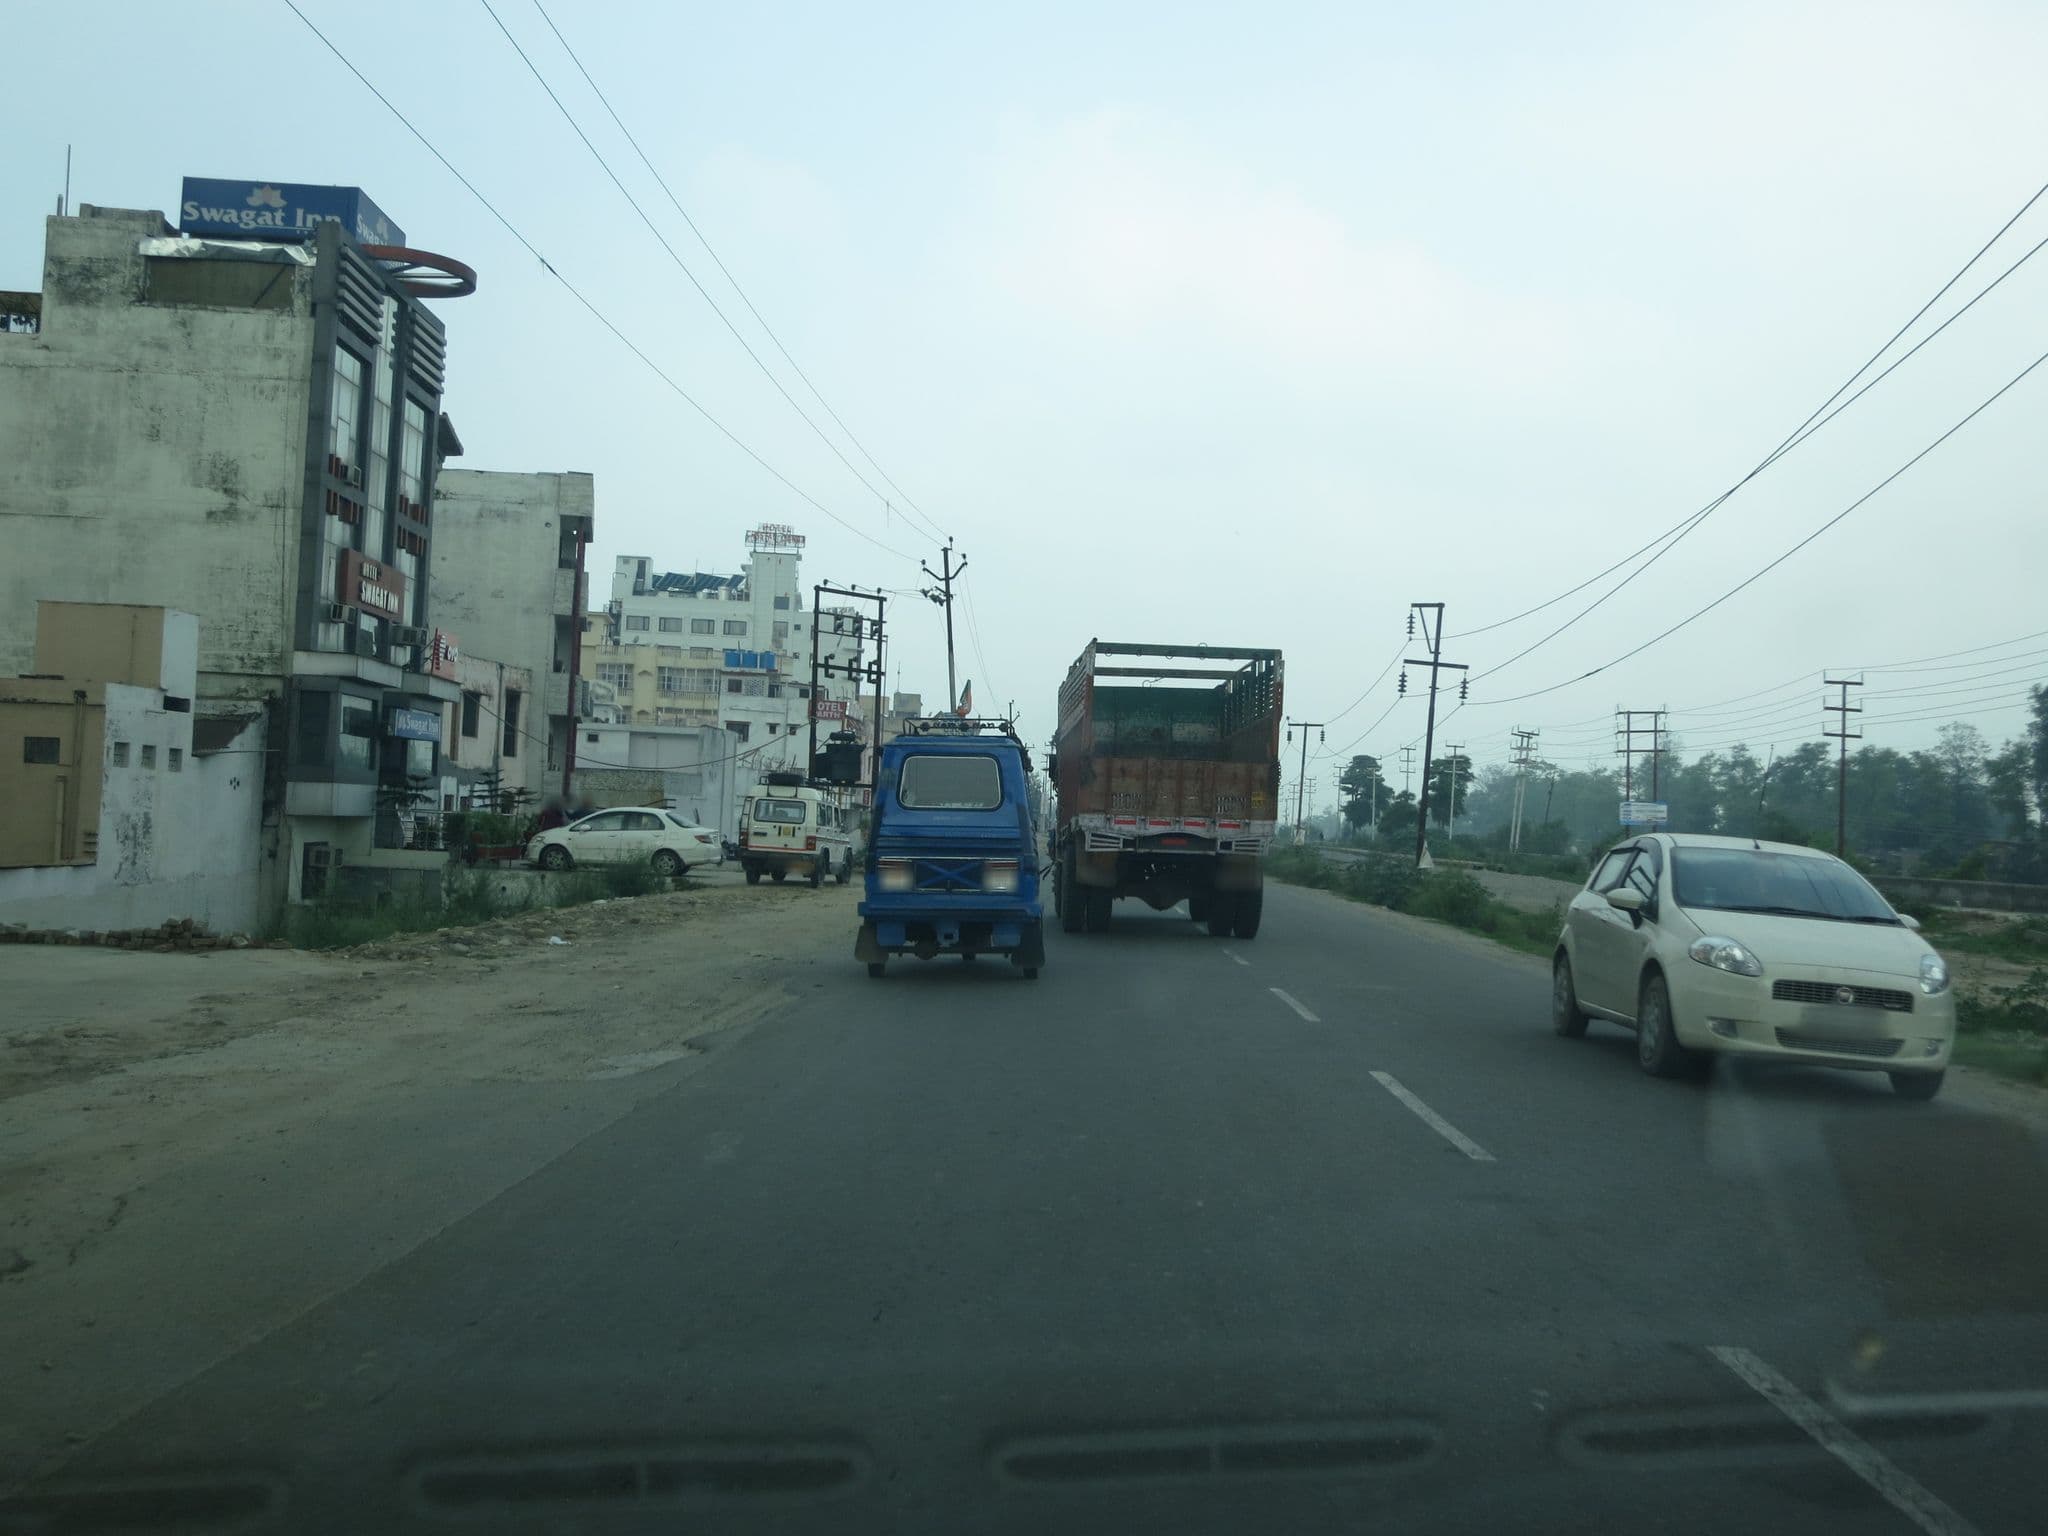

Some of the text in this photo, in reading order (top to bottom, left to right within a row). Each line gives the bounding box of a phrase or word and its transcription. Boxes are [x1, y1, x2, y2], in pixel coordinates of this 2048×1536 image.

[183, 201, 285, 229] Swagat
[361, 580, 388, 610] SWAGAT
[817, 701, 844, 712] OTEL
